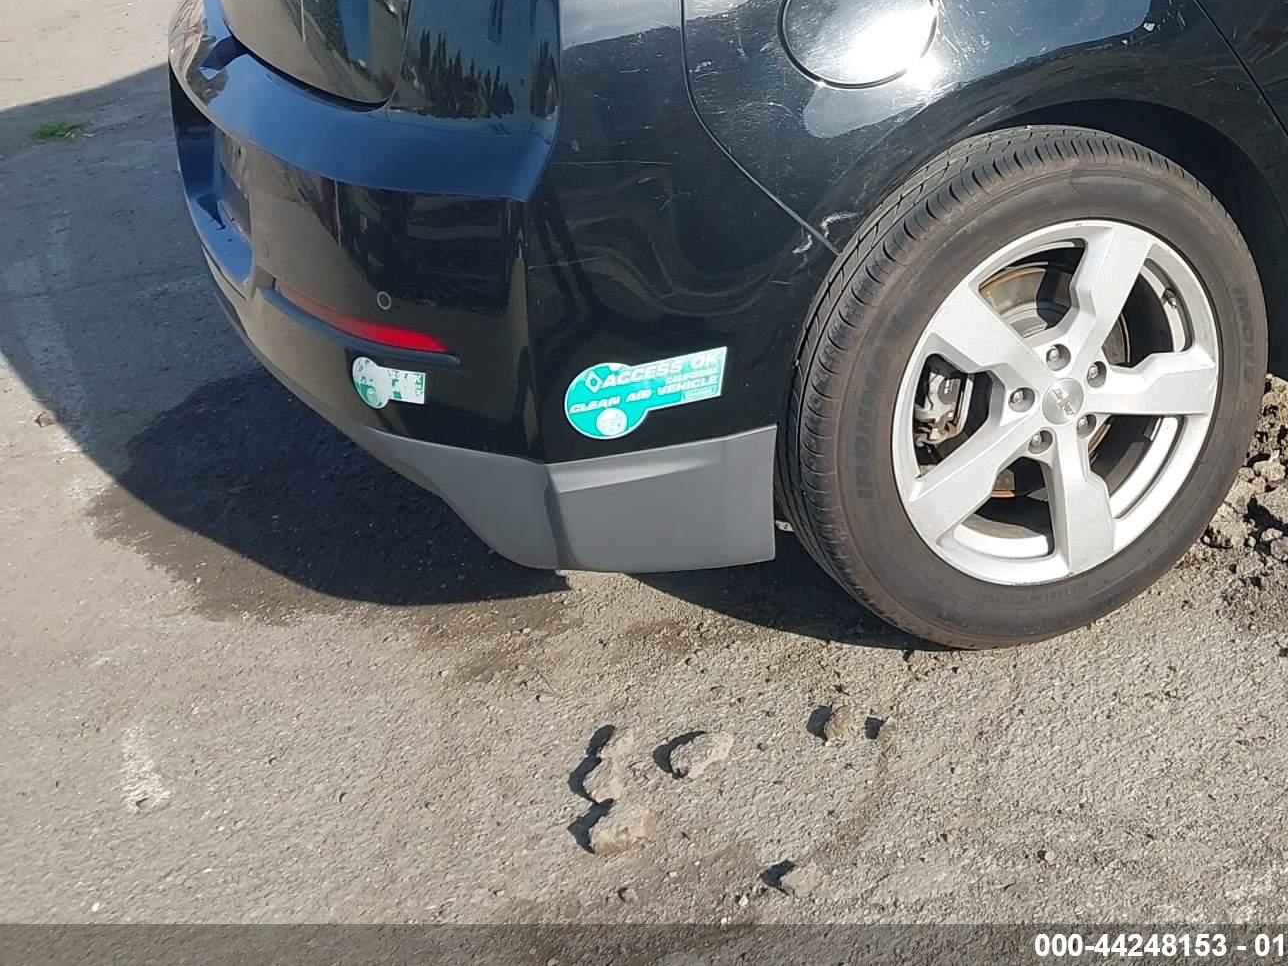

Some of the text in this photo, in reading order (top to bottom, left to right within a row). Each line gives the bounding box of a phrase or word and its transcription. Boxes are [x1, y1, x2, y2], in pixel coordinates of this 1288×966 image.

[601, 353, 717, 388] ACCESS OK
[570, 395, 621, 414] CLEAN
[625, 388, 653, 402] AIR
[656, 376, 718, 395] VEHICLE
